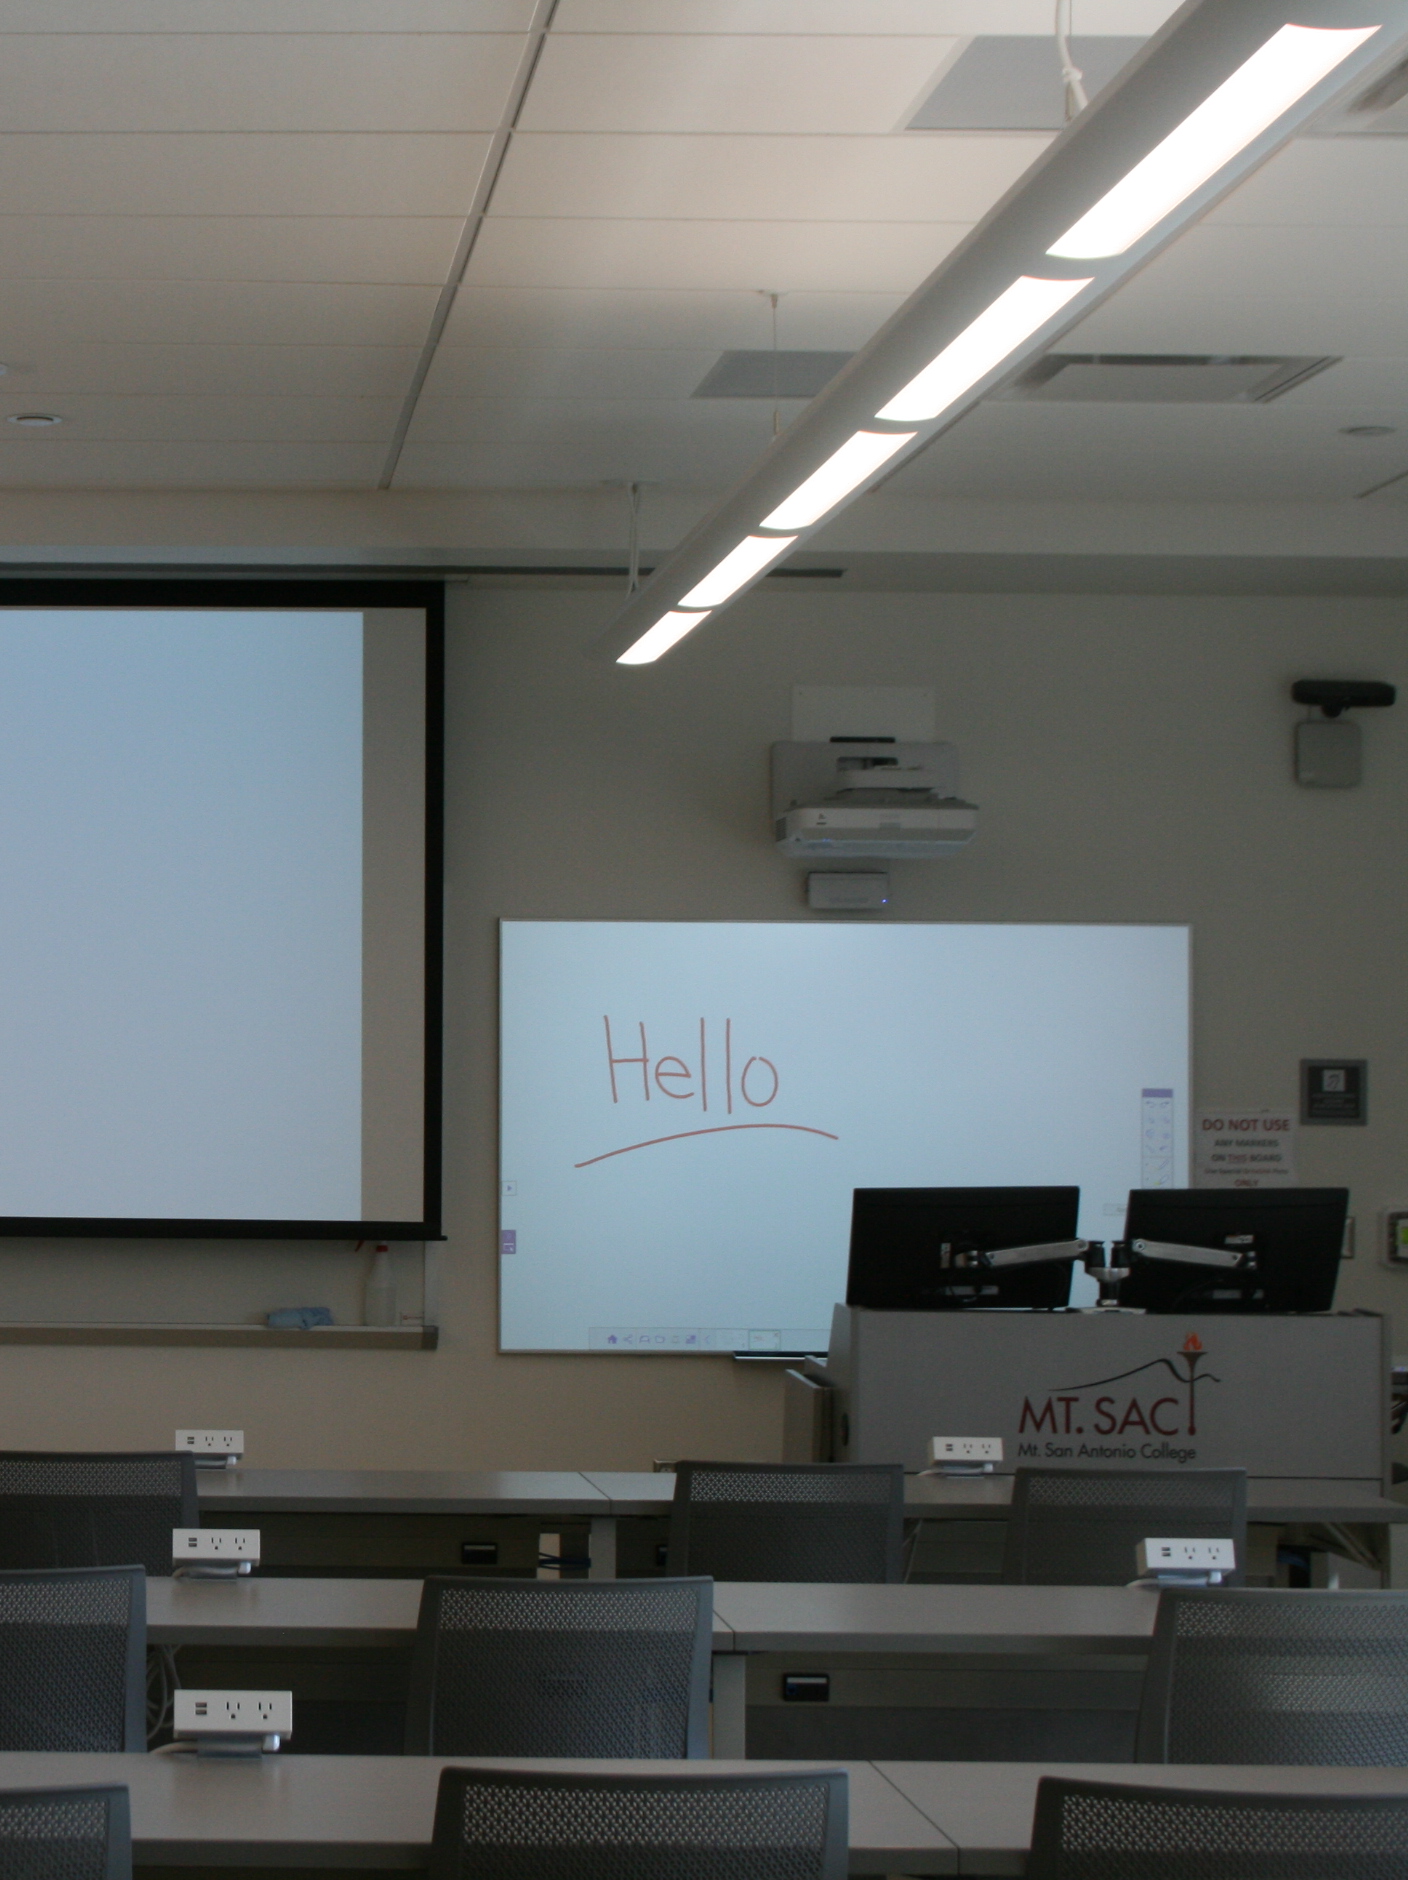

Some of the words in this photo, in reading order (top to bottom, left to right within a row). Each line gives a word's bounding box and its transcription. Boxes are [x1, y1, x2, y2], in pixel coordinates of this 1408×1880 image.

[603, 1014, 779, 1114] Hello
[1202, 1118, 1224, 1131] DO
[1228, 1118, 1259, 1131] NOT
[1262, 1118, 1291, 1131] USE
[1214, 1139, 1233, 1147] ANY
[1235, 1139, 1279, 1147] MARKERS
[1211, 1154, 1226, 1162] ON
[1250, 1154, 1283, 1162] BOARD
[1234, 1179, 1259, 1187] ONLY
[1018, 1396, 1084, 1435] MT.
[1094, 1396, 1179, 1436] SAC
[1018, 1442, 1040, 1457] Mt.
[1045, 1442, 1073, 1458] San
[1077, 1443, 1136, 1459] Antonio
[1140, 1442, 1196, 1464] College
